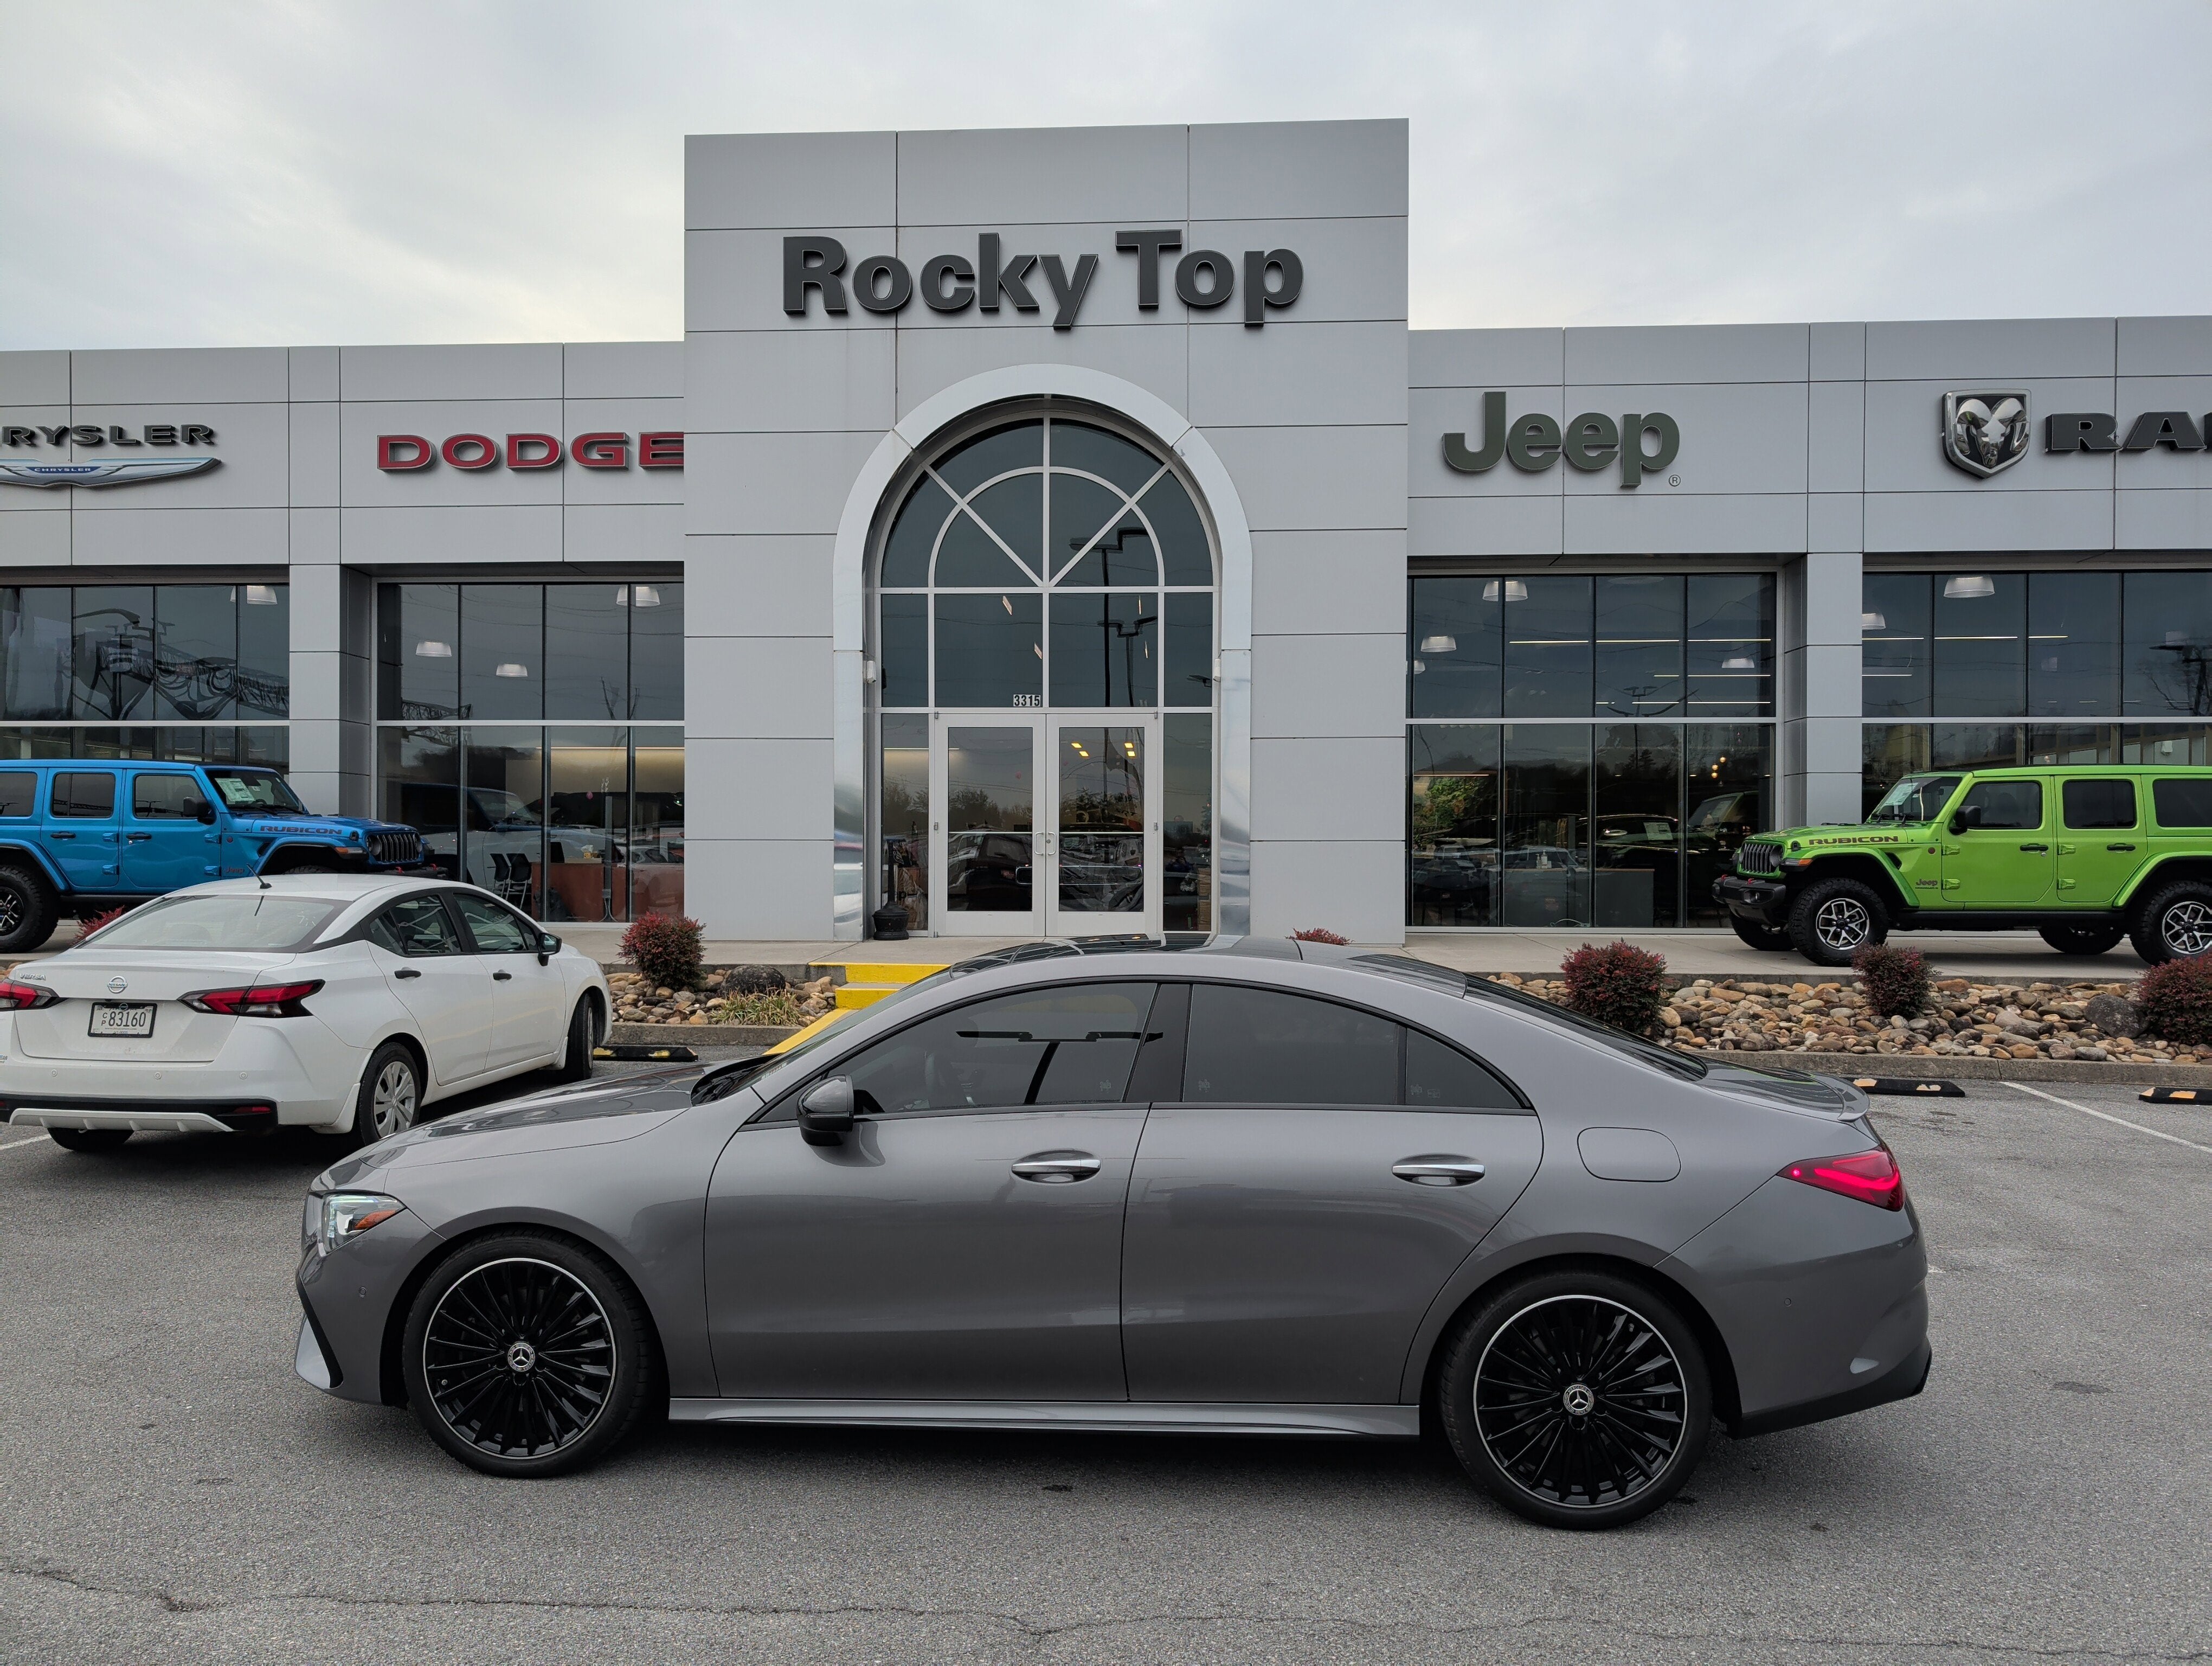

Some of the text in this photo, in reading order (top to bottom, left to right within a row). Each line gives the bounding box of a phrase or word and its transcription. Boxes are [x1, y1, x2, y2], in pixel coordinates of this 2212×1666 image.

[783, 229, 1303, 329] Rocky Top
[1442, 392, 1680, 488] Jeep
[2045, 411, 2212, 453] RA
[377, 432, 684, 471] DODGE
[1014, 695, 1040, 706] 3315
[260, 825, 343, 835] RUBICON
[1809, 836, 1899, 845] RUBICON
[1915, 878, 1938, 886] Jeep
[108, 1011, 146, 1027] 83160
